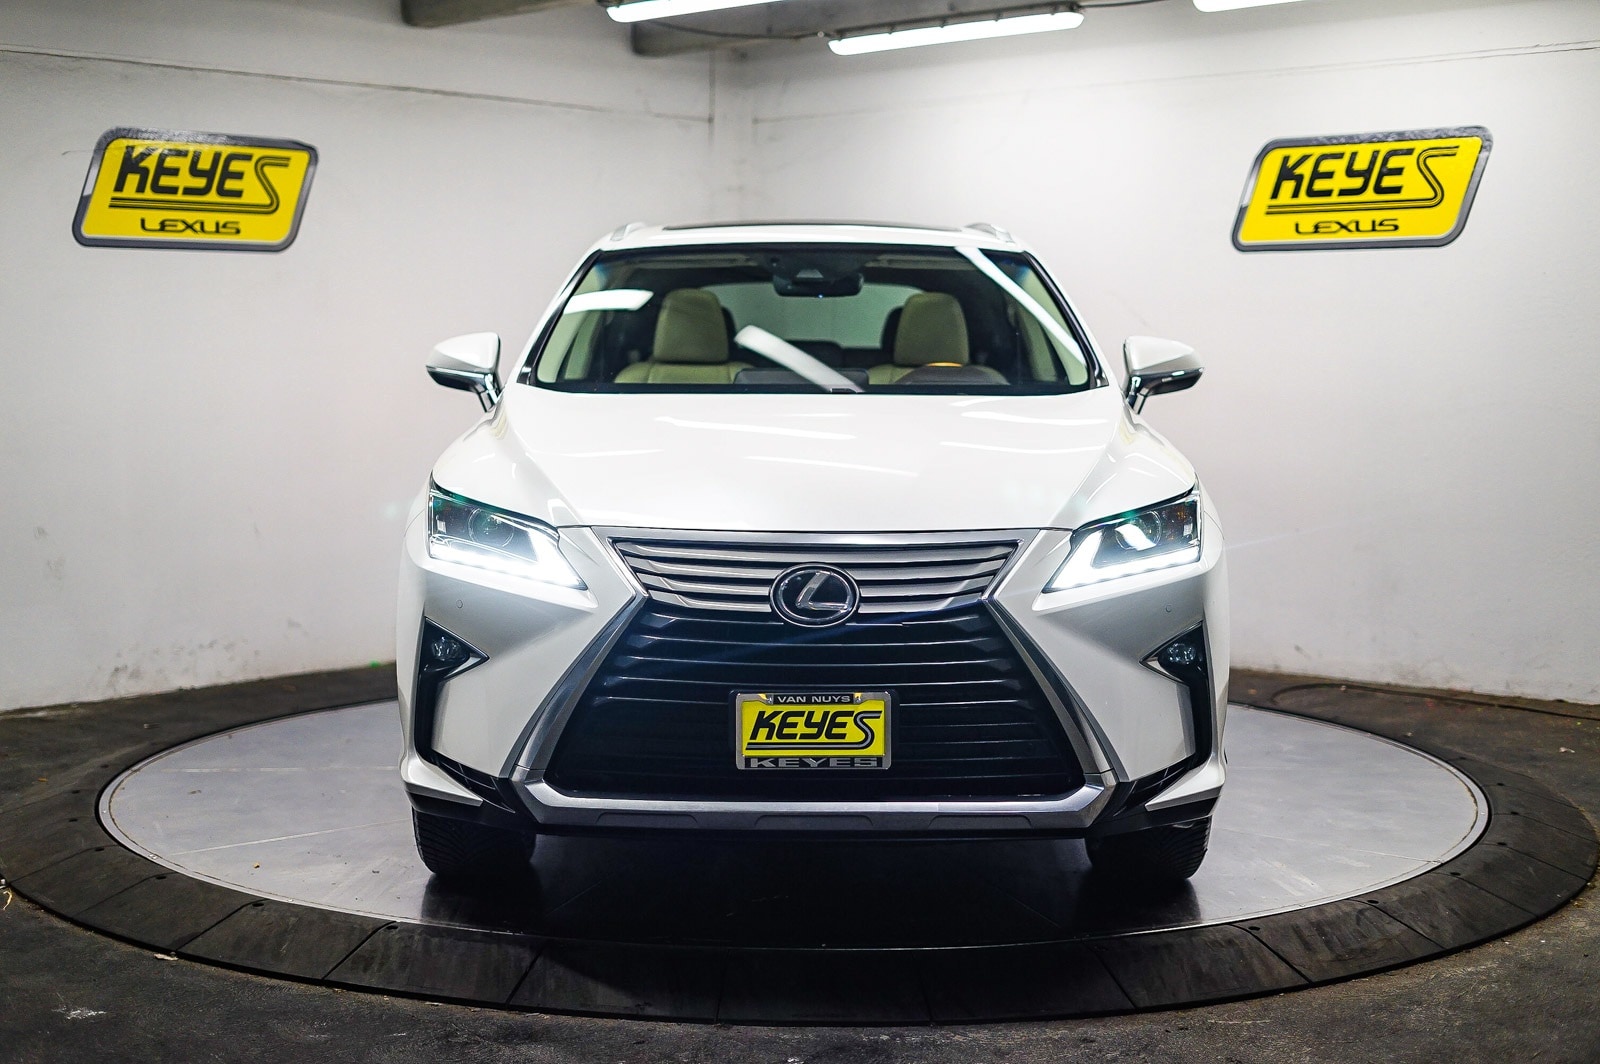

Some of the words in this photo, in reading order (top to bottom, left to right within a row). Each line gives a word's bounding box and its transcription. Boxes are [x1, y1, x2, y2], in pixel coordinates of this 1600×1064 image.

[109, 145, 291, 214] KEYES
[1266, 146, 1459, 214] KEYES
[140, 217, 241, 235] LEXUS
[1295, 218, 1400, 235] LEXUS
[777, 695, 807, 703] VAN
[811, 695, 851, 703] NUYS
[746, 710, 882, 750] KEYES
[750, 757, 878, 768] KEYES
